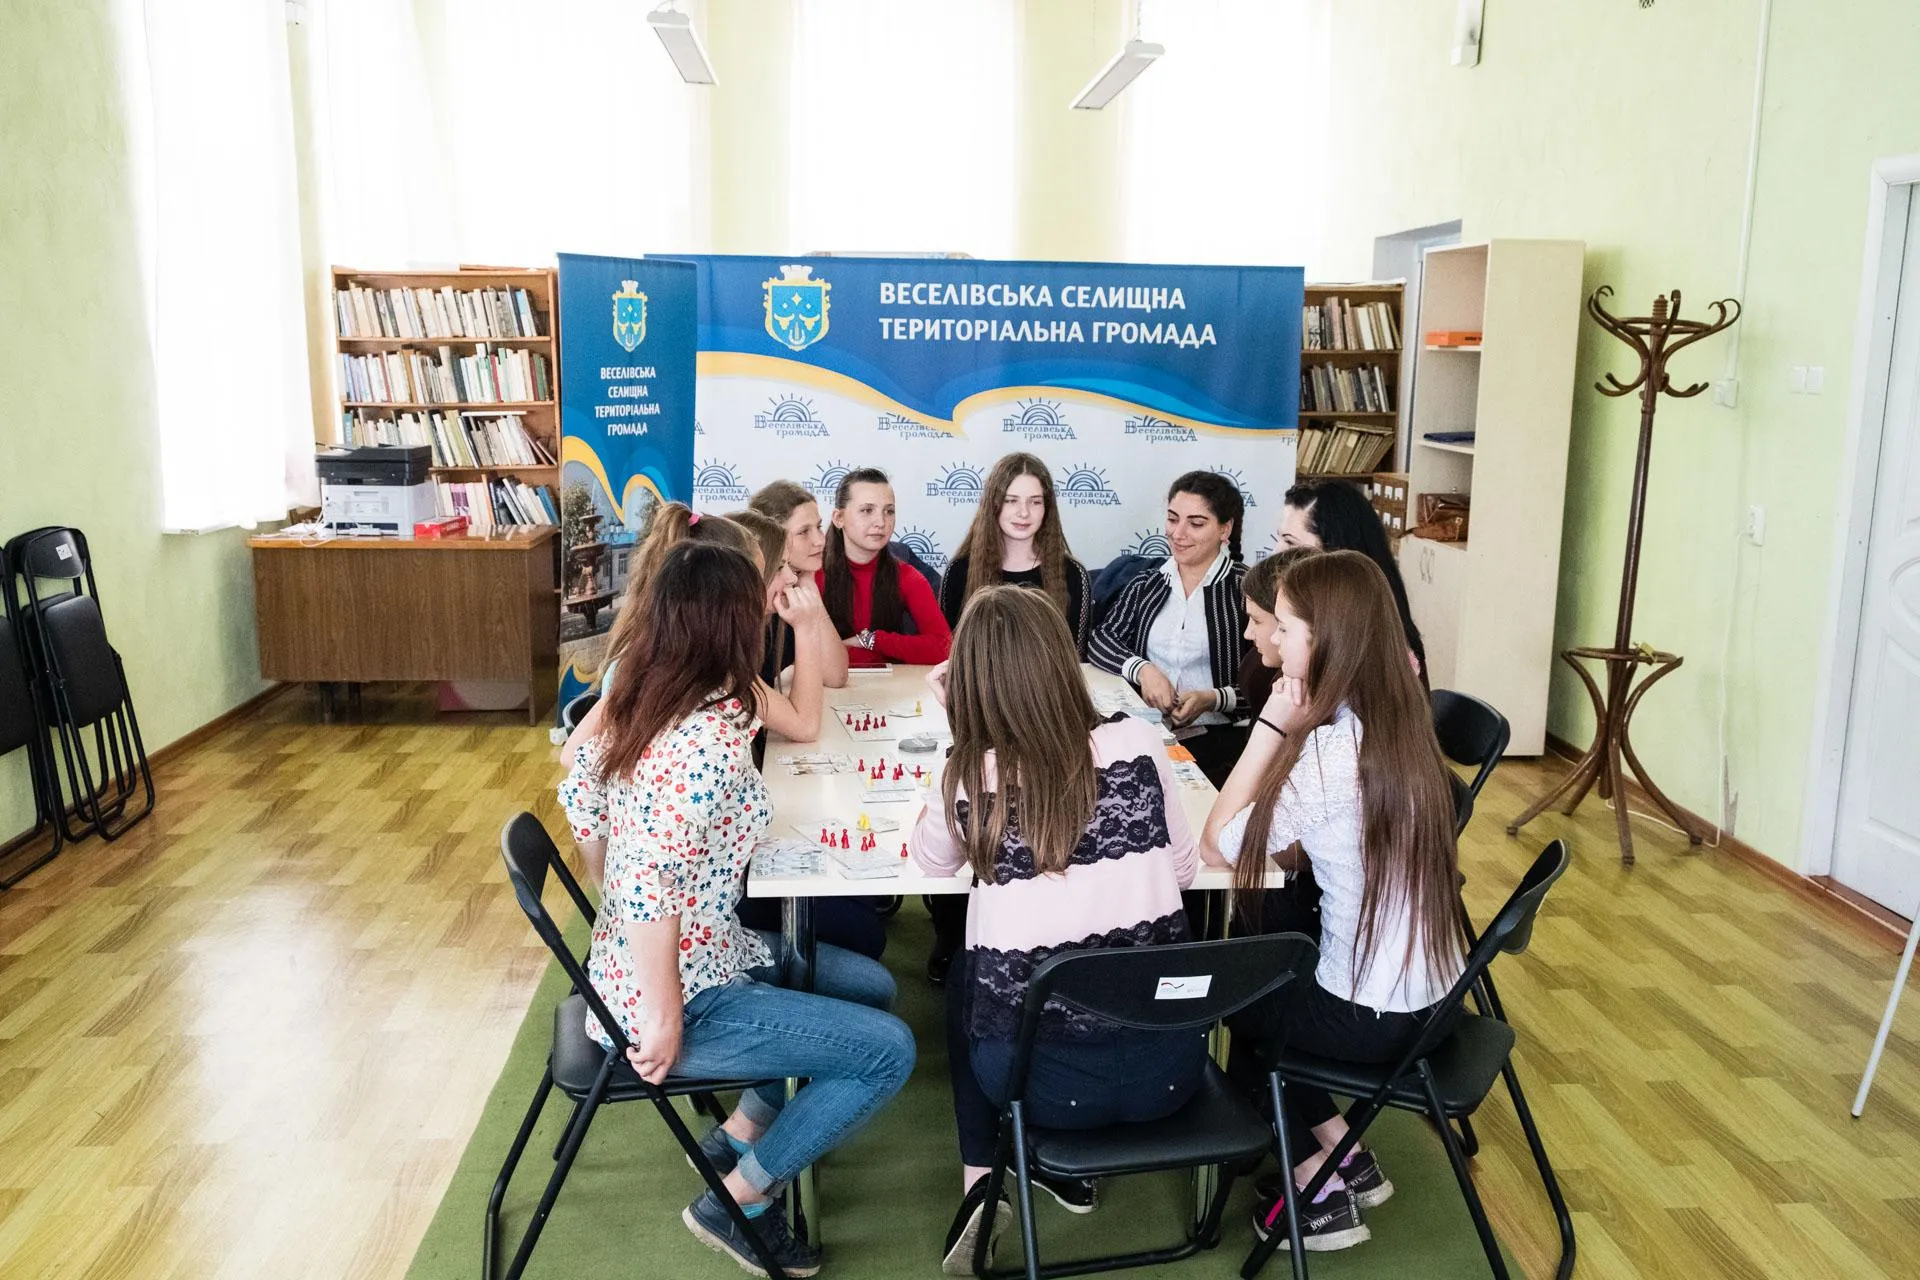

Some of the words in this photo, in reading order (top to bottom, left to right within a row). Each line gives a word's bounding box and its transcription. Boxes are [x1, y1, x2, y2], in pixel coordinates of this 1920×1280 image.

[880, 283, 1054, 307] ВЕСЕЛІВСЬКА
[1061, 286, 1186, 313] СЕЛИЩНА
[879, 318, 1085, 343] ТЕРИТОРІАЛЬНА
[1092, 322, 1217, 349] ГРОМАДА
[600, 366, 656, 379] ВЕСЕЛІВСЬКА
[608, 385, 648, 399] СЕЛИЩНА
[595, 403, 660, 418] ТЕРИТОРІАЛЬНА
[607, 422, 648, 436] ГРОМАДА
[1310, 1214, 1333, 1232] SPORTS
